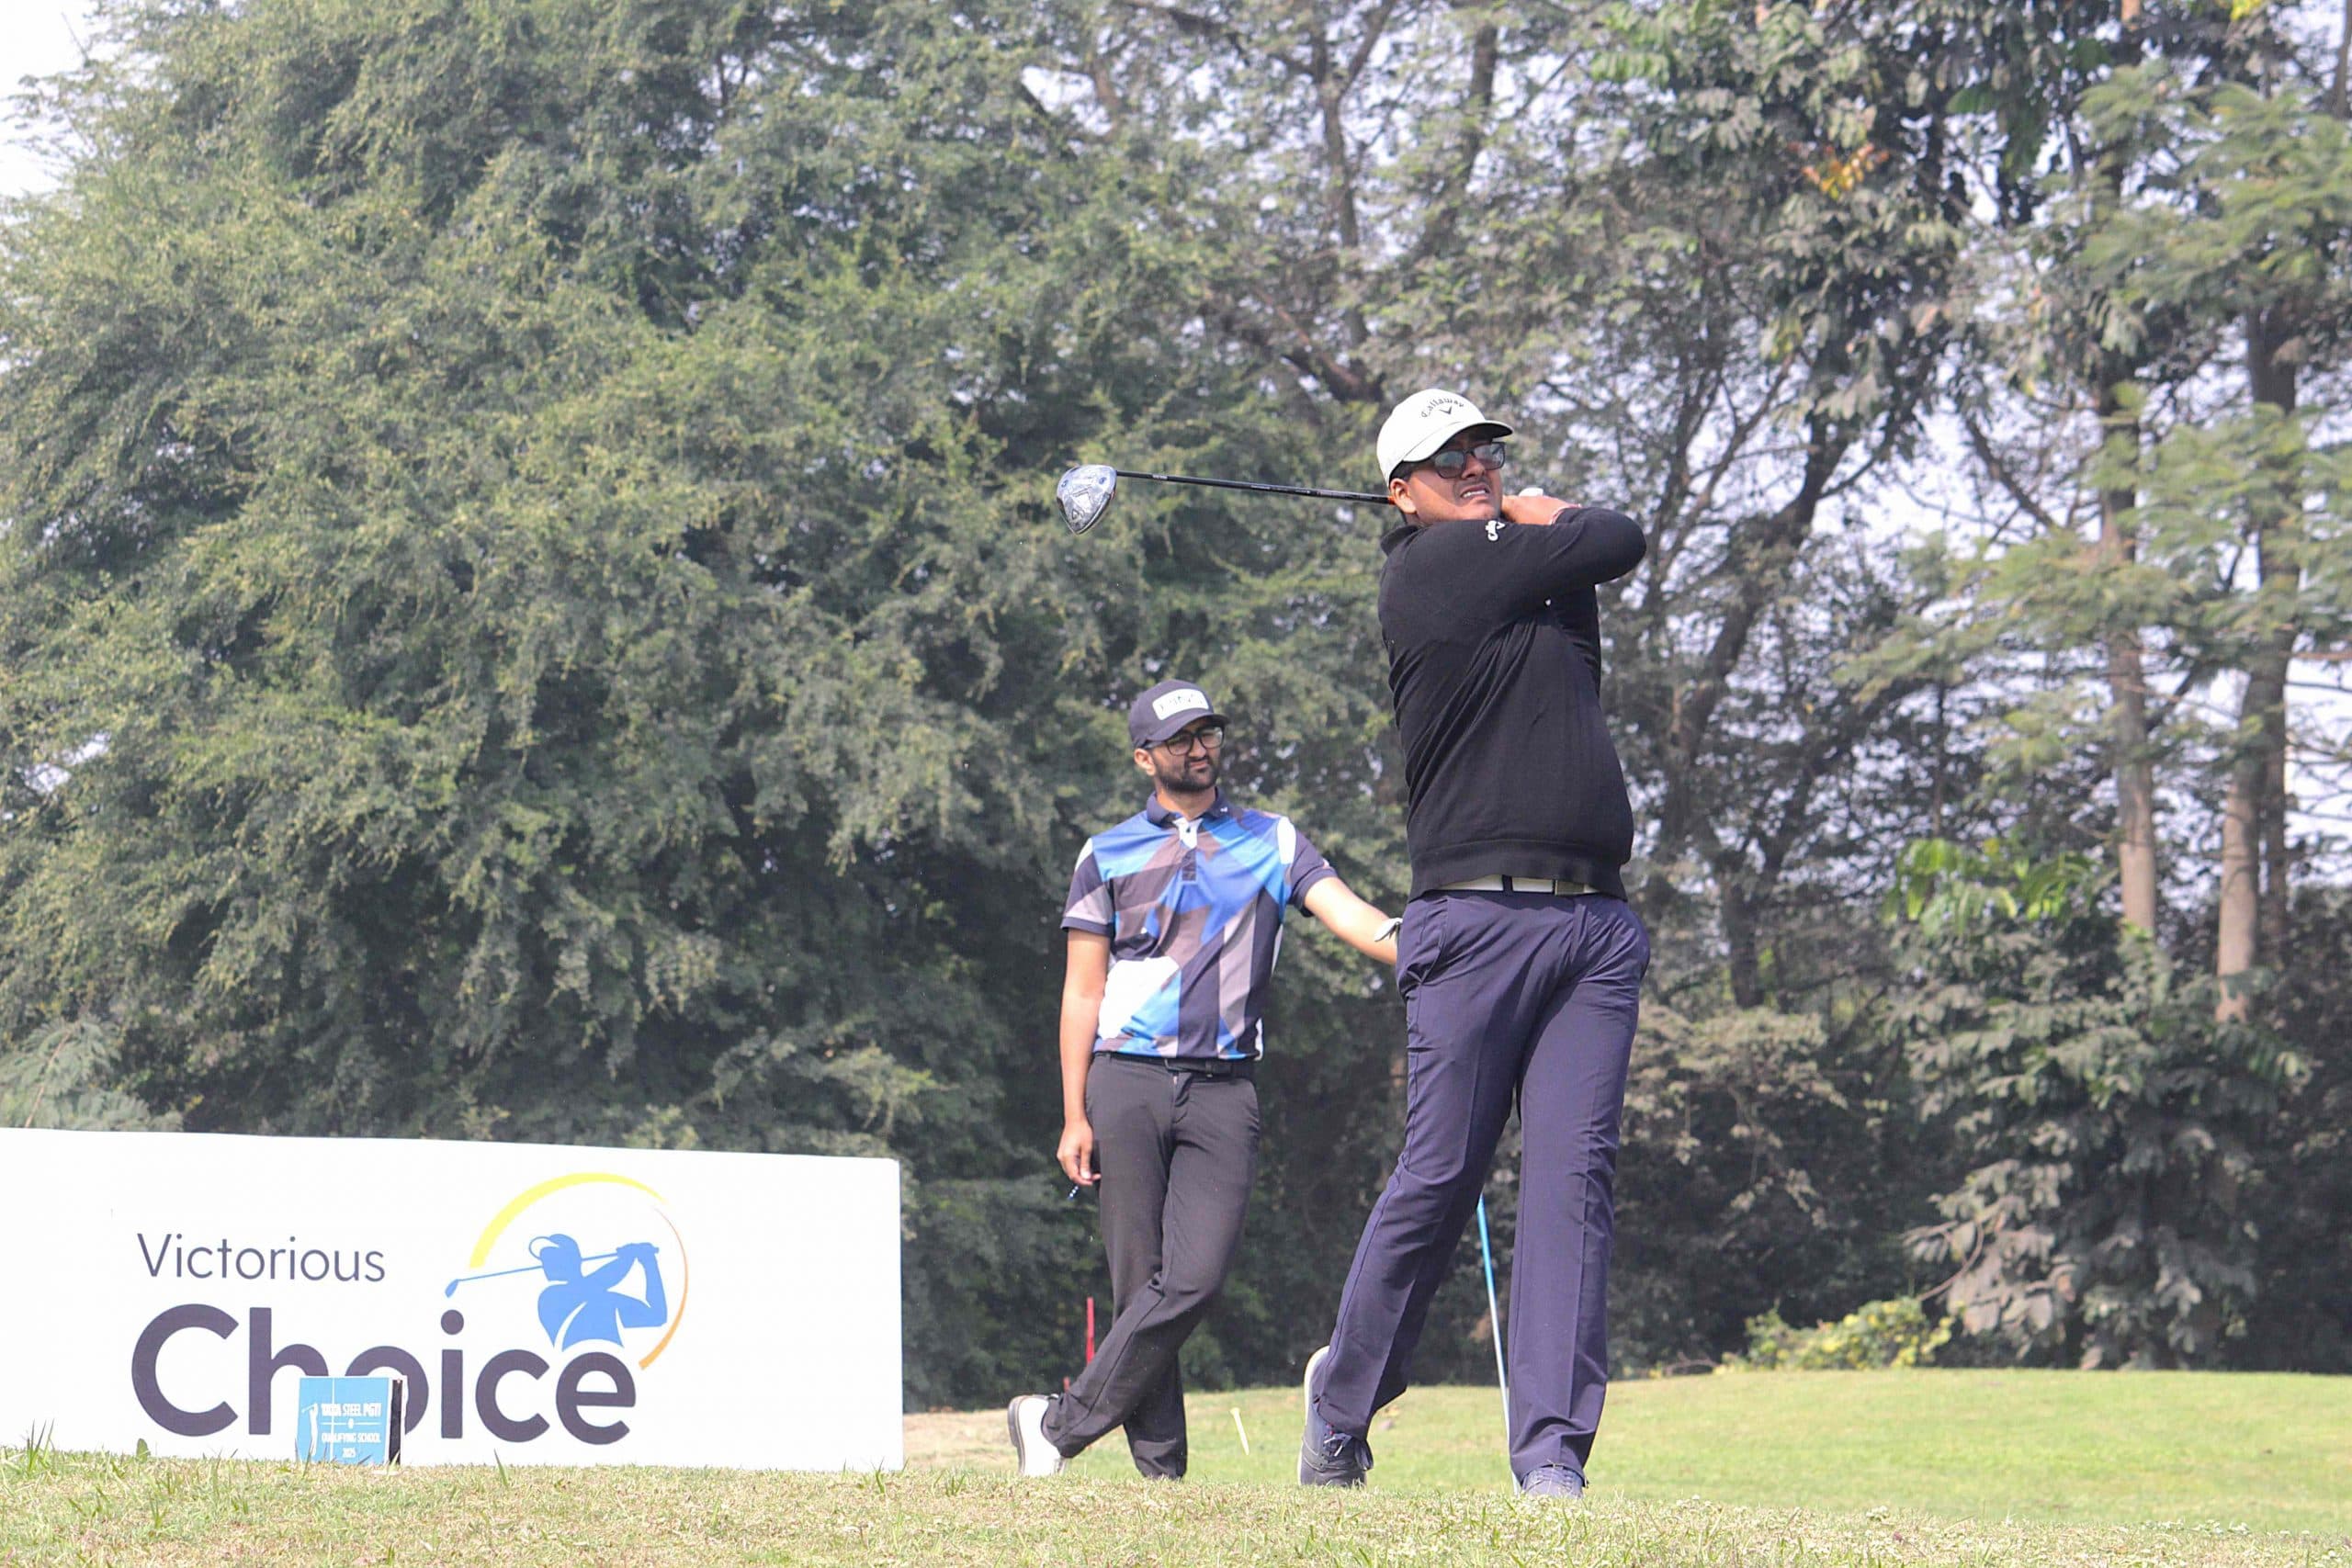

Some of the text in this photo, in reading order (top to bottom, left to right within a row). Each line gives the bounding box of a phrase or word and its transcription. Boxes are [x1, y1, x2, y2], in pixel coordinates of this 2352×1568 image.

[137, 1234, 385, 1281] Victorious
[131, 1303, 635, 1444] Choice
[357, 1432, 381, 1443] SCHOOL
